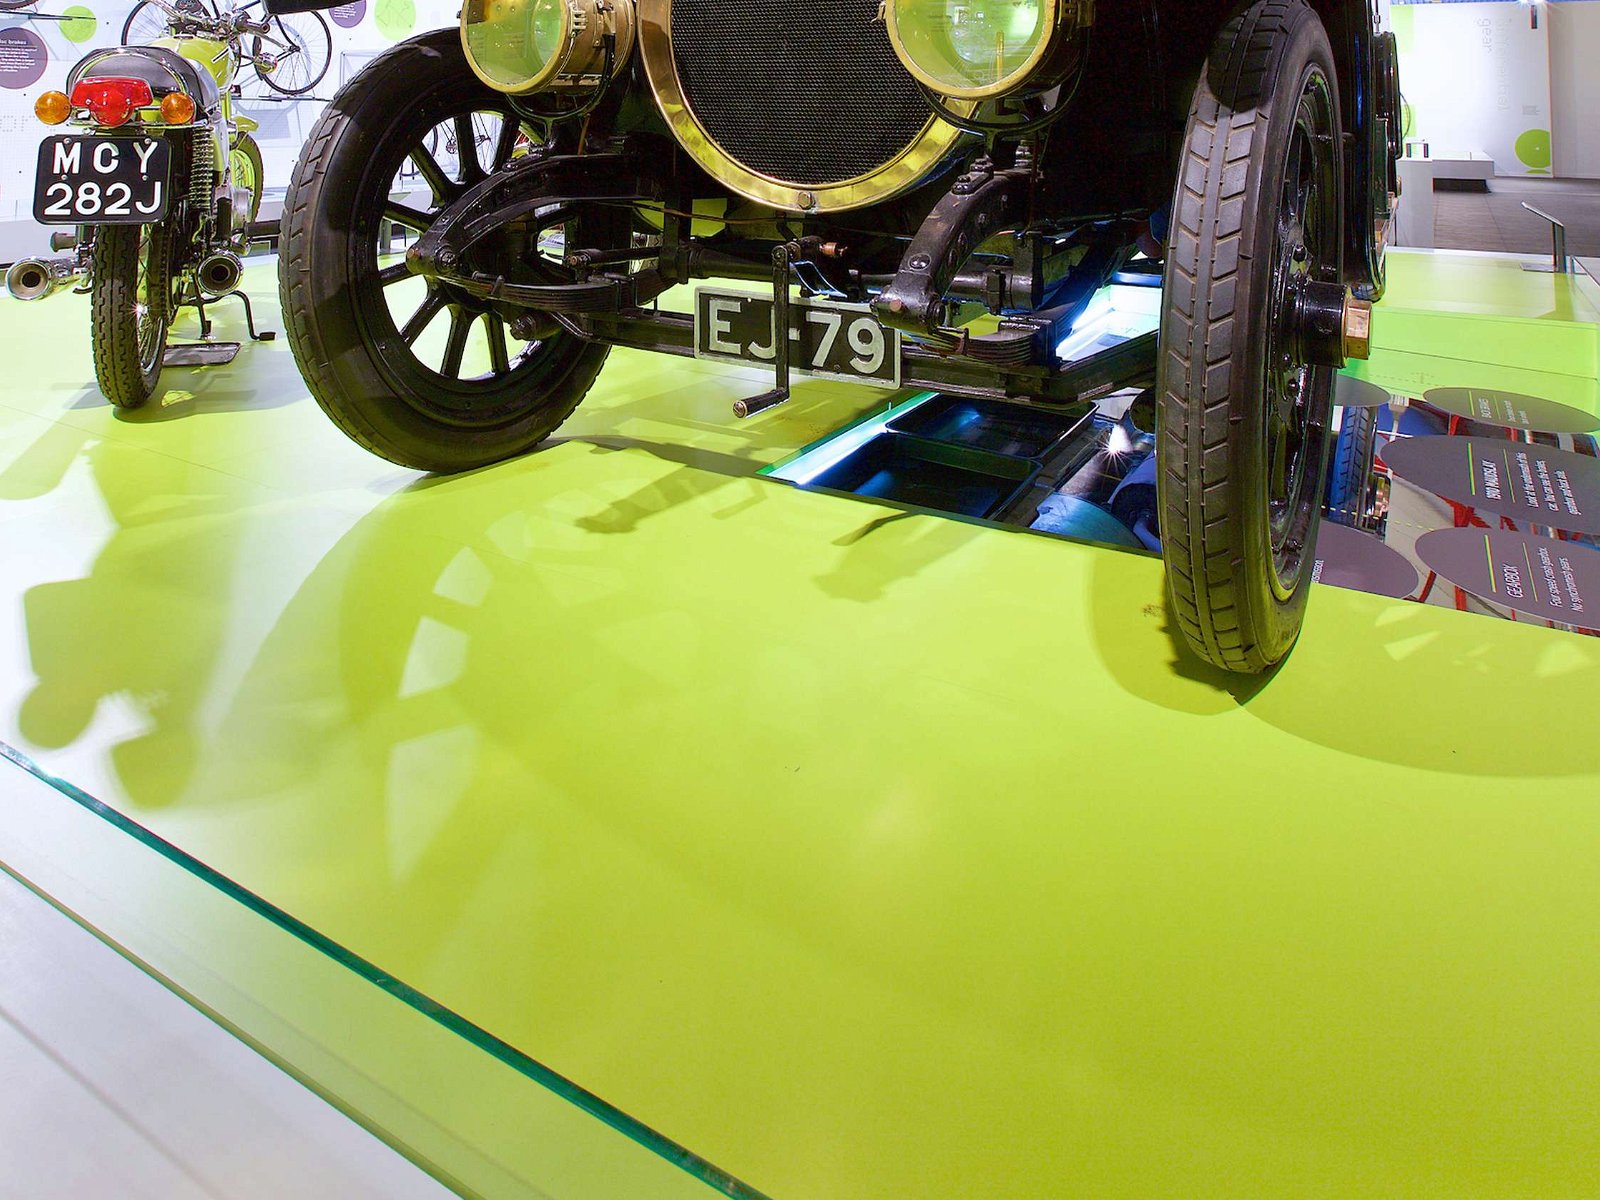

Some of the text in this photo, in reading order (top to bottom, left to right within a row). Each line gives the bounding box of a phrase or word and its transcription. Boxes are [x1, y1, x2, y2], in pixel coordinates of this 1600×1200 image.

[1477, 18, 1492, 53] gear
[44, 181, 161, 215] 282J
[1502, 563, 1523, 598] GEARBOX
[1544, 579, 1560, 594] speed
[1549, 594, 1563, 607] Four
